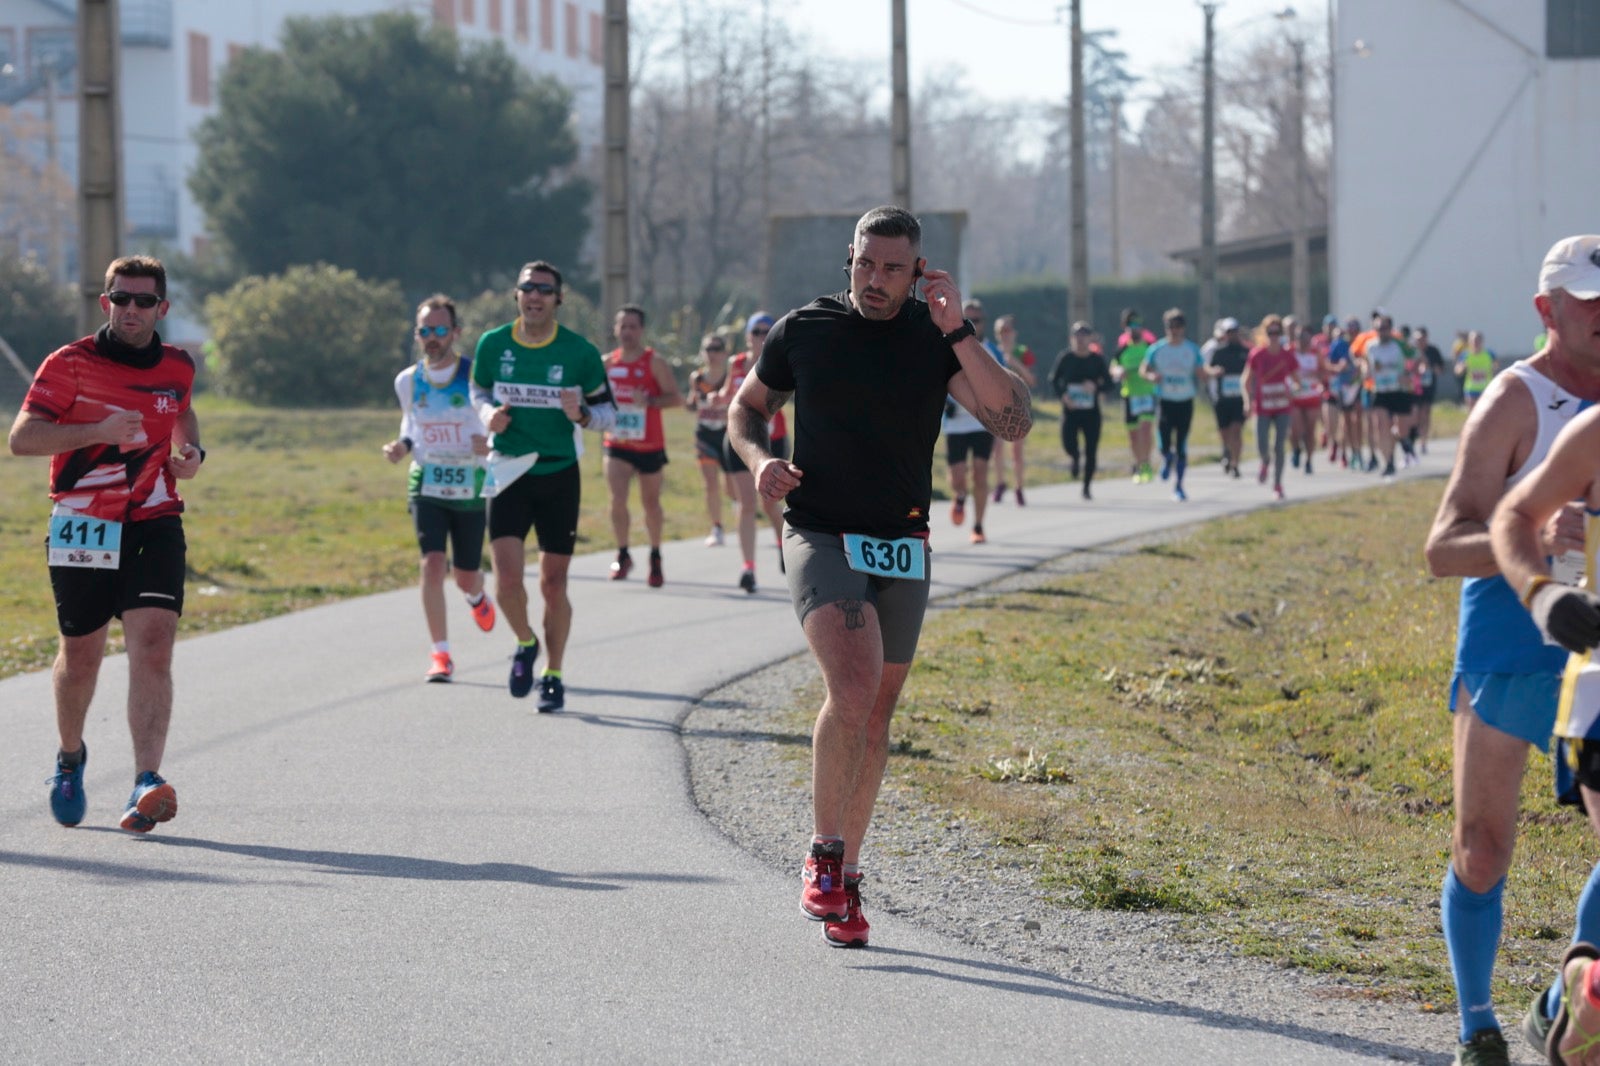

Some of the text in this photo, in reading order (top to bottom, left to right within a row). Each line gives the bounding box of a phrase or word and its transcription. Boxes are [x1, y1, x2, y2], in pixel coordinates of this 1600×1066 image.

[433, 466, 466, 484] 955
[59, 520, 106, 546] 411
[861, 541, 911, 573] 630
